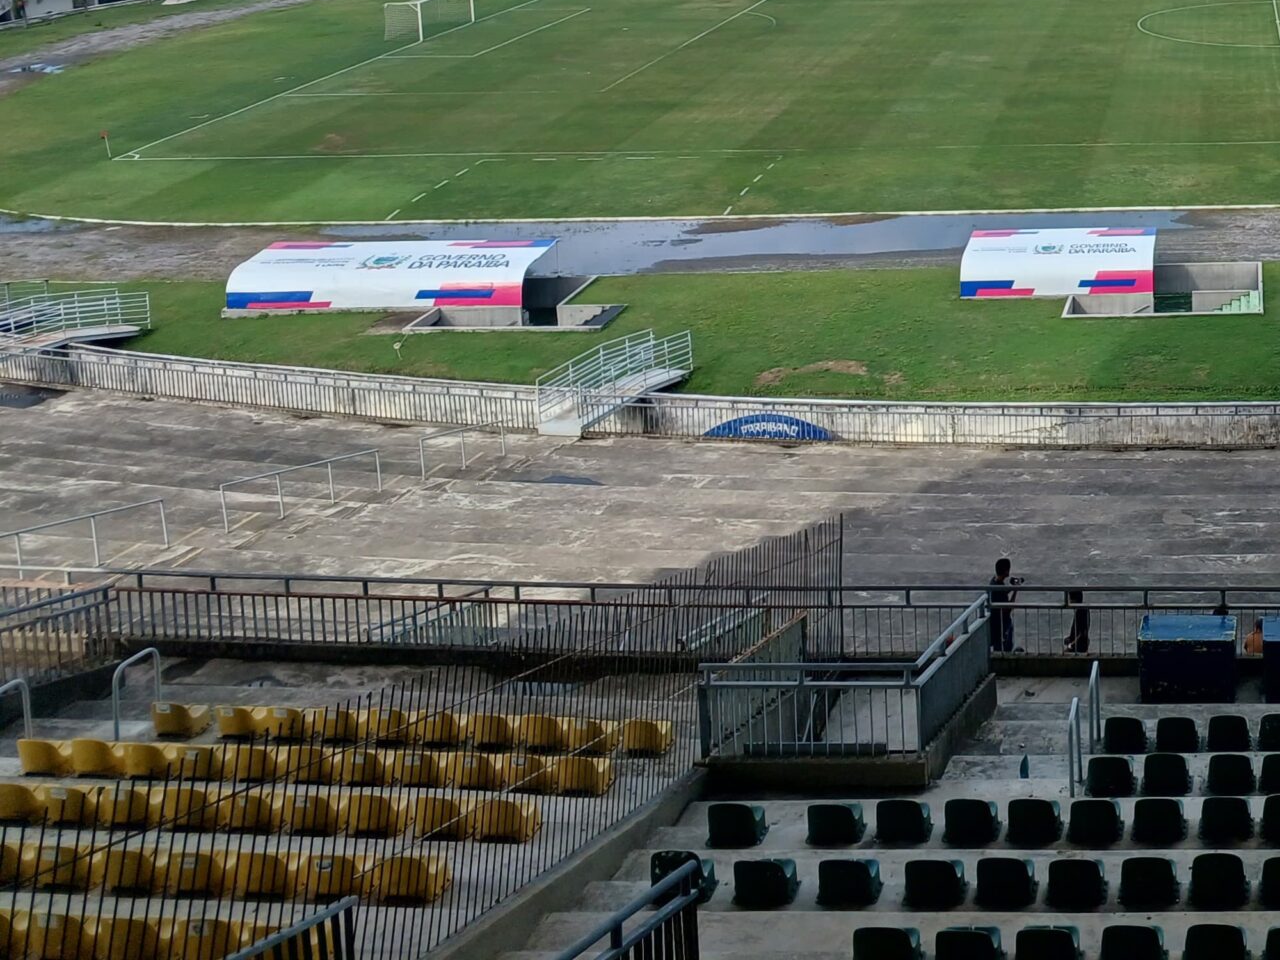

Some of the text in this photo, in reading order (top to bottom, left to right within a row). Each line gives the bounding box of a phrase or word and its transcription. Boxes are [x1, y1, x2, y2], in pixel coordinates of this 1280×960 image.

[418, 253, 506, 261] GOVERNO
[407, 260, 433, 269] DA
[740, 421, 799, 436] PARAIBANO
